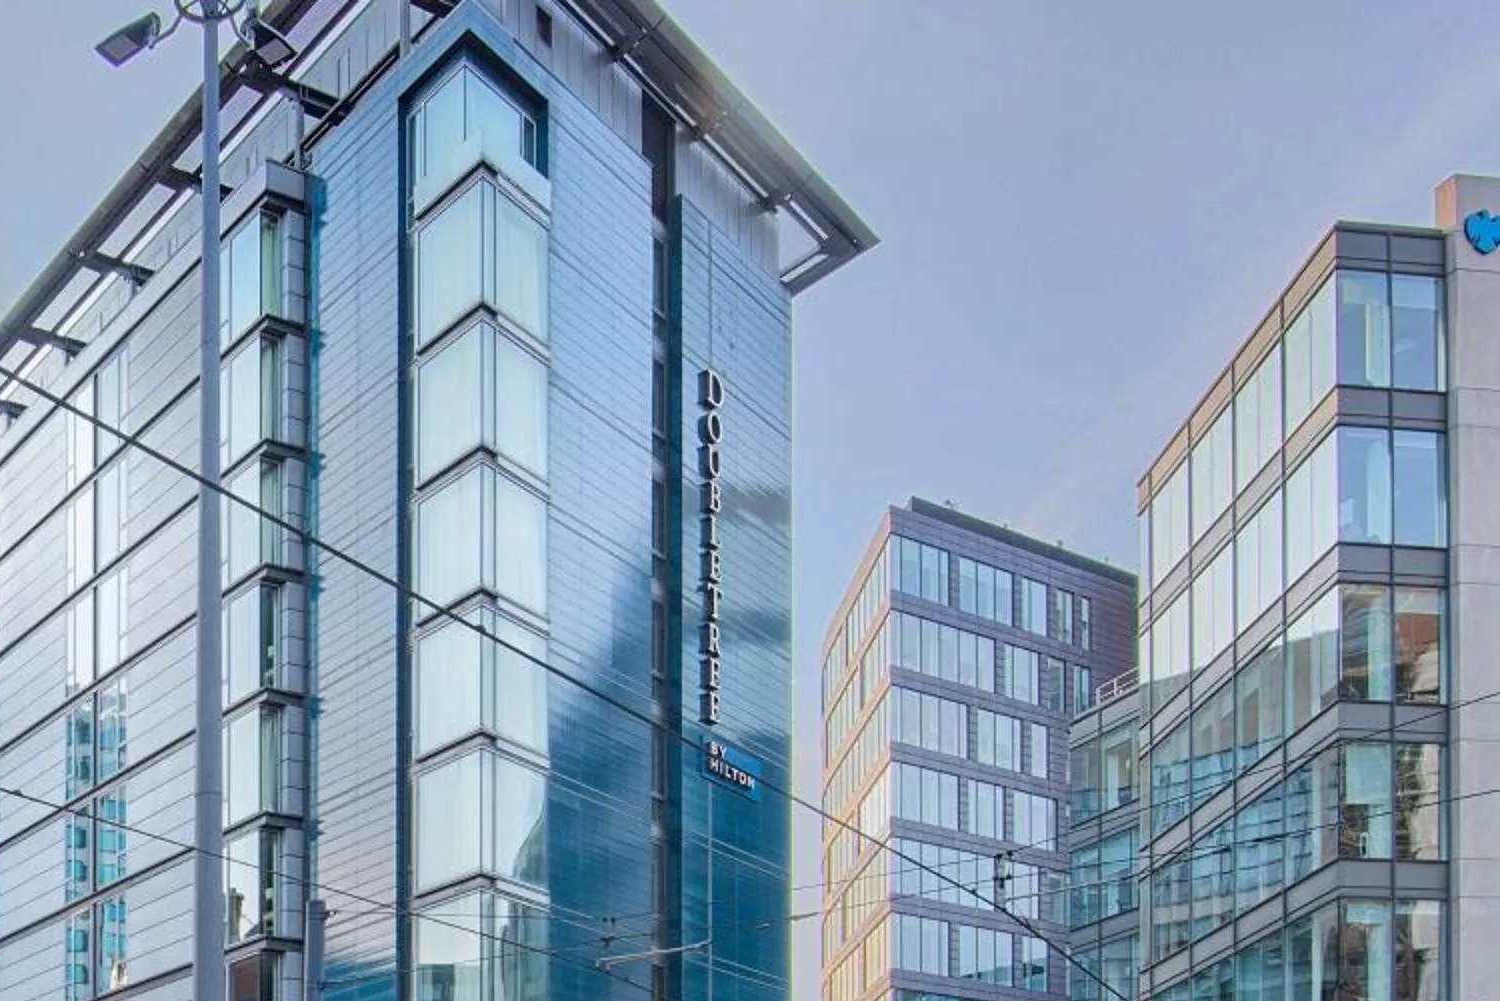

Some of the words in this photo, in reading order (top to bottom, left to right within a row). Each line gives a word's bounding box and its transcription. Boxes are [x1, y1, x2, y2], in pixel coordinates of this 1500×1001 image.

[703, 369, 725, 725] DOUBLETREE
[710, 741, 727, 759] BY
[709, 756, 755, 790] HILTON
